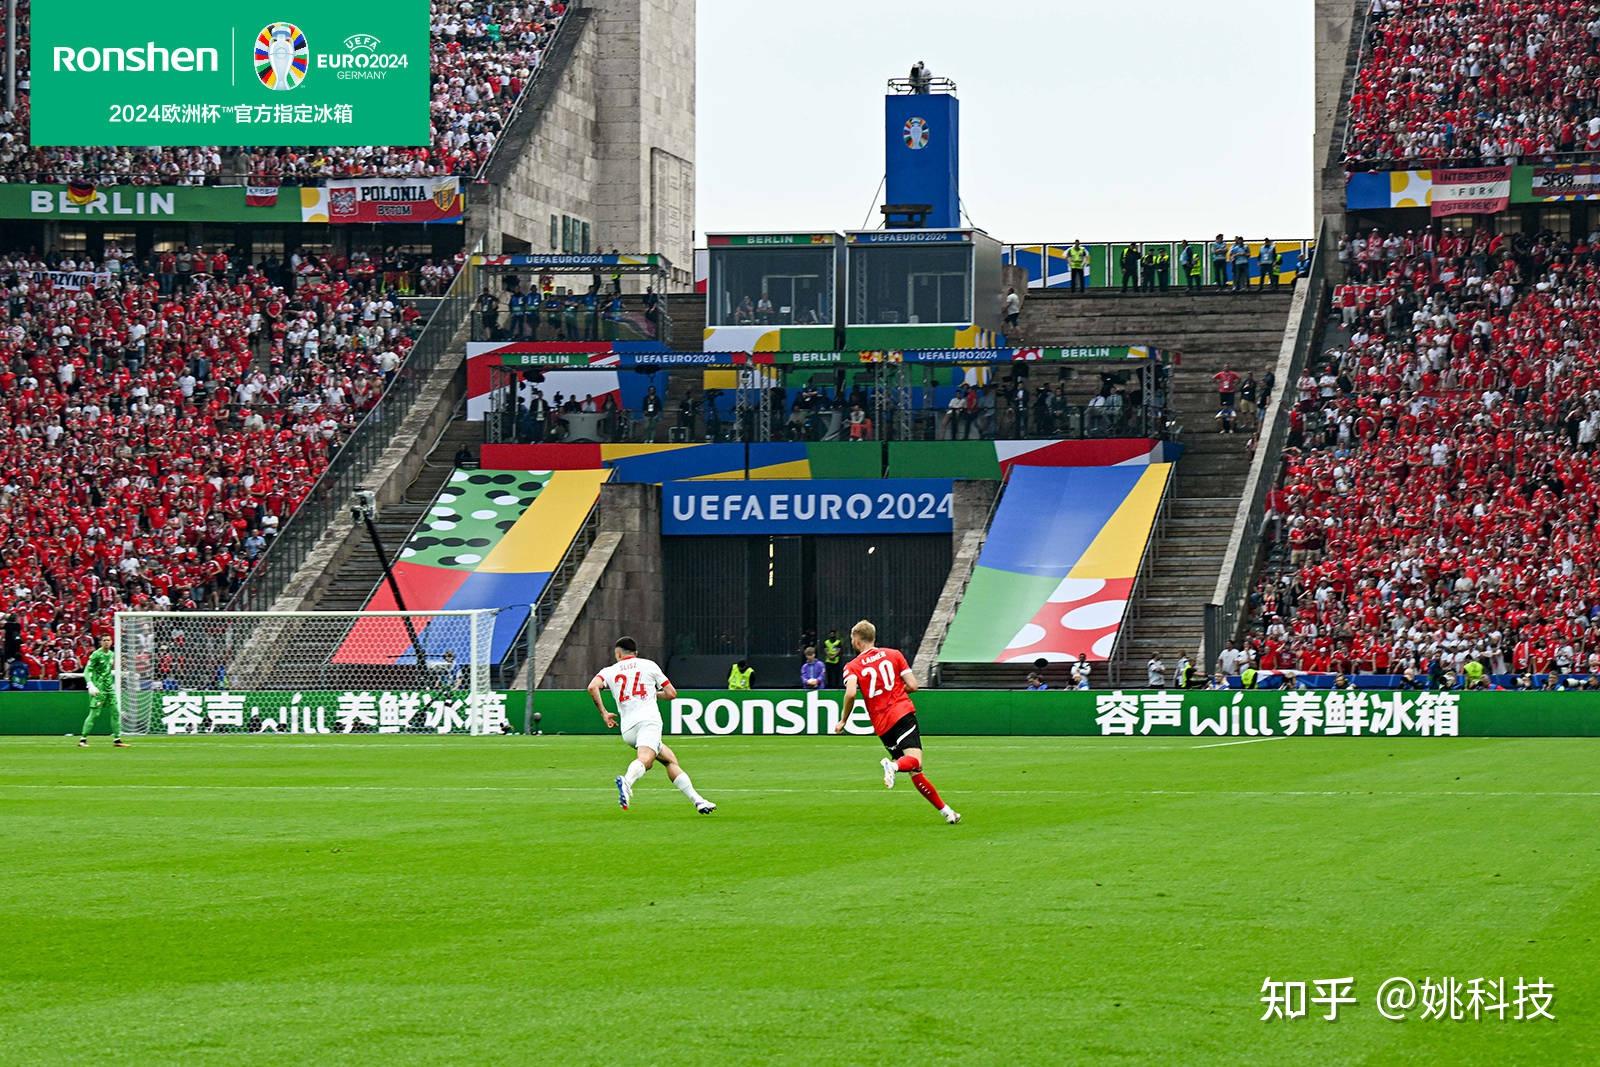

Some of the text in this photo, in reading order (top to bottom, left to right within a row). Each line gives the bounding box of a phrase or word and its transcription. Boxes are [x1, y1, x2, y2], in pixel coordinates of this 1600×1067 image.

[31, 190, 175, 215] BERLIN
[361, 185, 427, 201] POLONIA
[747, 235, 794, 244] BERLIN
[521, 353, 570, 364] BERLIN
[793, 352, 841, 362] BERLIN
[1061, 348, 1110, 358] BERLIN
[614, 671, 648, 702] 24
[861, 659, 895, 698] 20
[1095, 690, 1184, 736] 容声
[1279, 690, 1460, 736] 养鲜冰箱
